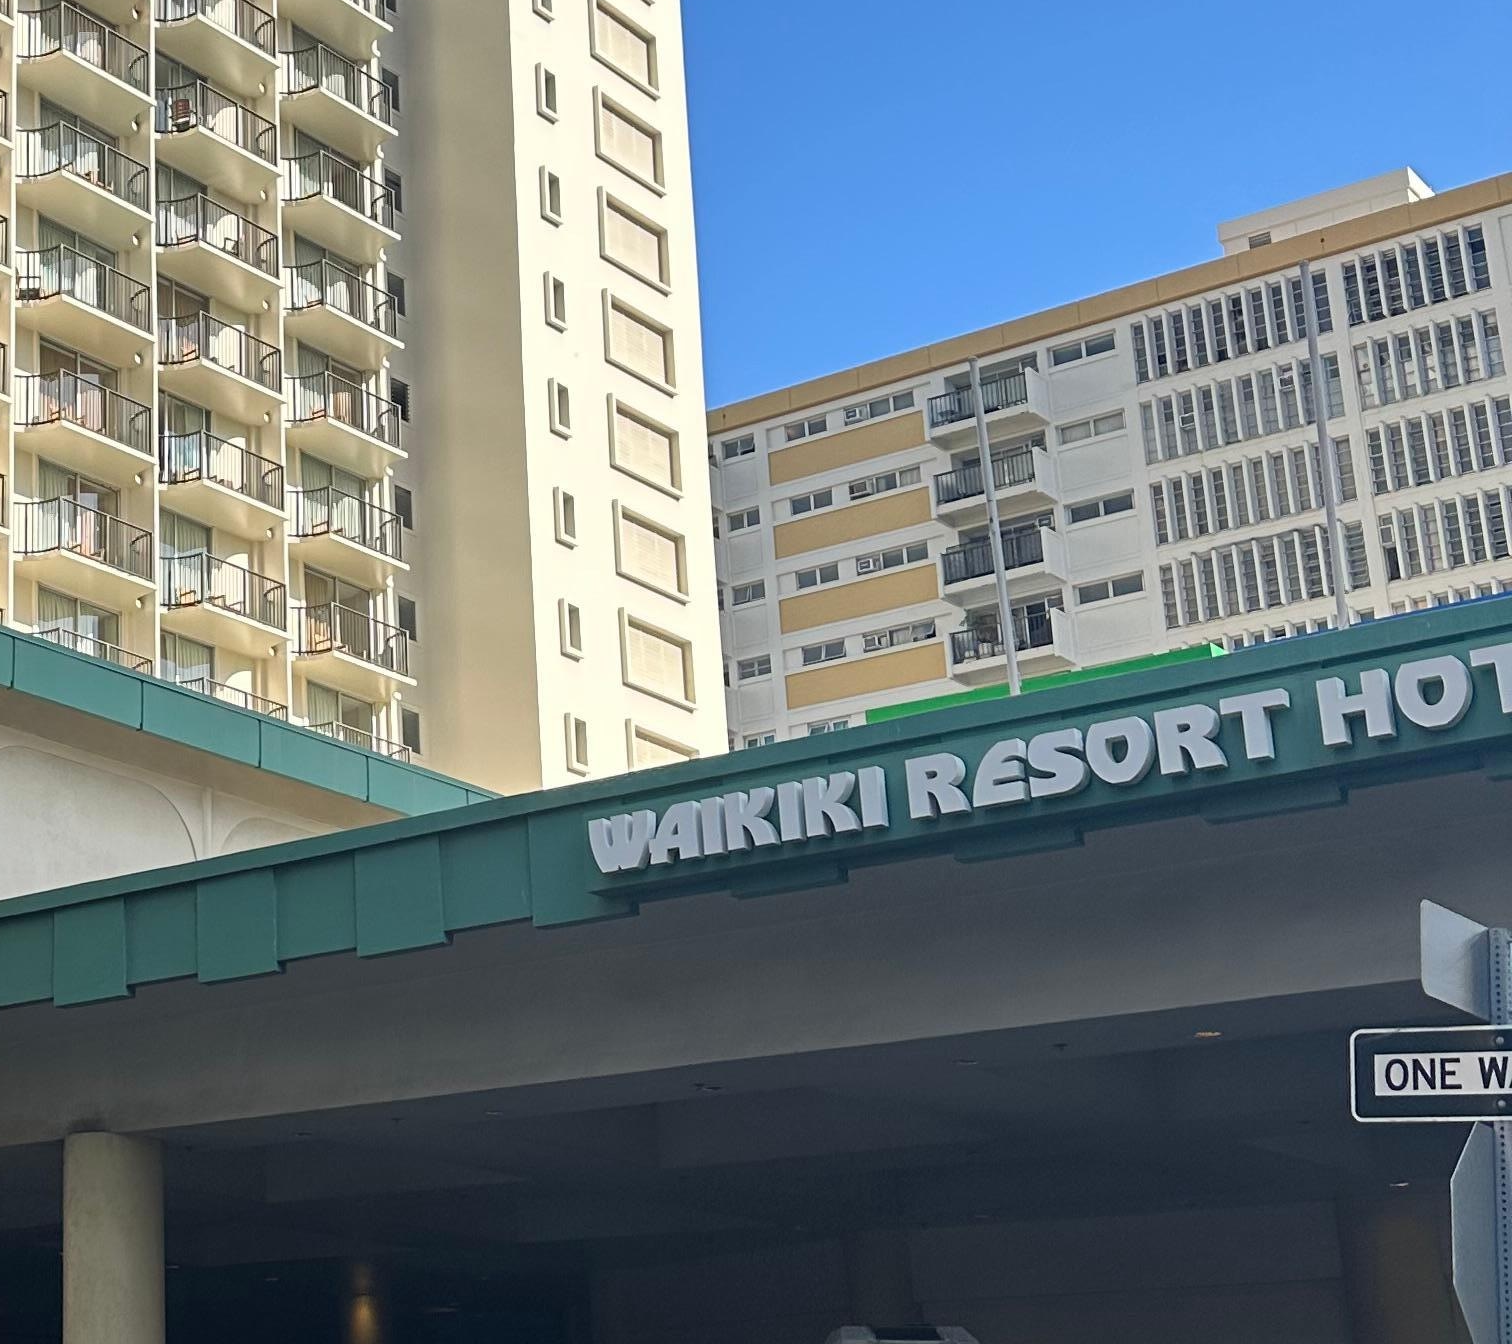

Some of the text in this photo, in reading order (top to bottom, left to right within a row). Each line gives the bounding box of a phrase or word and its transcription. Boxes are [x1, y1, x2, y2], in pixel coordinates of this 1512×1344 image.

[588, 765, 889, 874] WAIKIKI
[905, 688, 1291, 820] RESORT
[1385, 1056, 1512, 1091] ONE W
